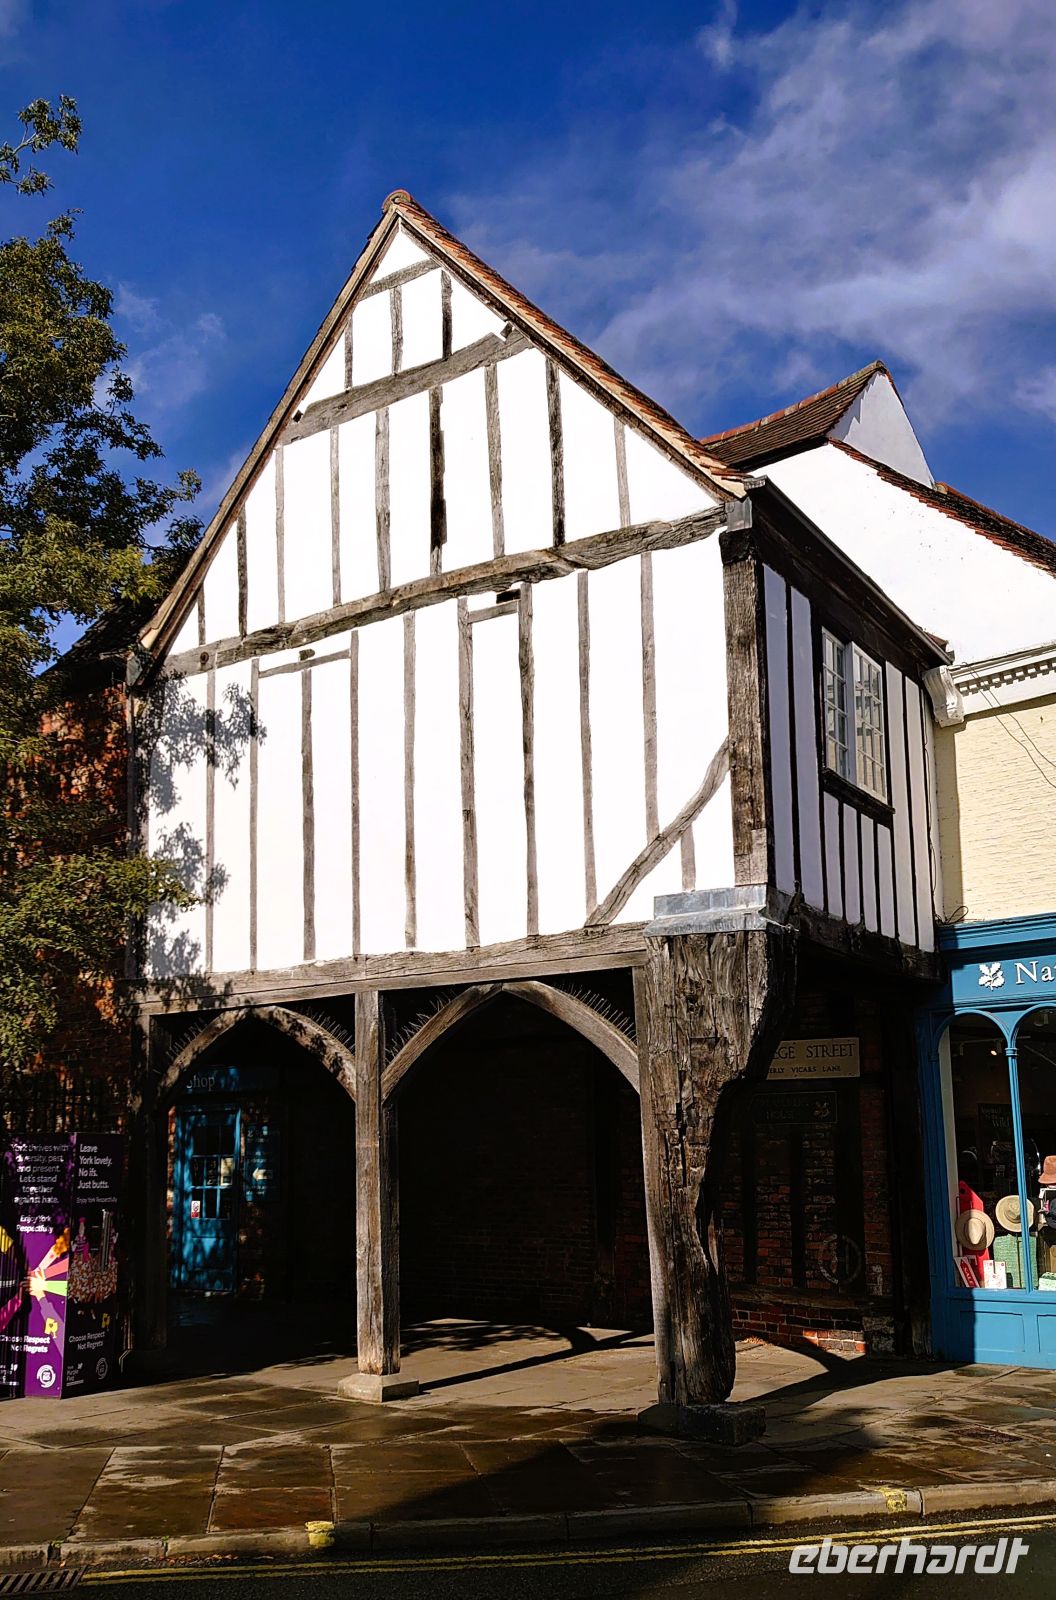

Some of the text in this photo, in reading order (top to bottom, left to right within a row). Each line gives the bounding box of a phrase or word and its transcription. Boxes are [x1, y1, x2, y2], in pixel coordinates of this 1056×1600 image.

[1014, 960, 1056, 985] Na
[806, 1043, 855, 1058] STREET
[767, 1066, 785, 1074] ERLY
[10, 1143, 69, 1152] York thrives with
[79, 1143, 98, 1153] Leave
[79, 1155, 113, 1167] York lovely.
[16, 1164, 31, 1173] and
[78, 1167, 88, 1177] No
[36, 1174, 58, 1183] stand
[77, 1179, 110, 1189] Just butts.
[22, 1184, 54, 1195] together
[14, 1194, 41, 1206] against
[20, 1214, 52, 1224] Enjoy York
[23, 1334, 50, 1345] Respect
[68, 1330, 106, 1343] Choose Respect
[23, 1344, 49, 1354] Regrets
[76, 1340, 104, 1351] Not Regrets
